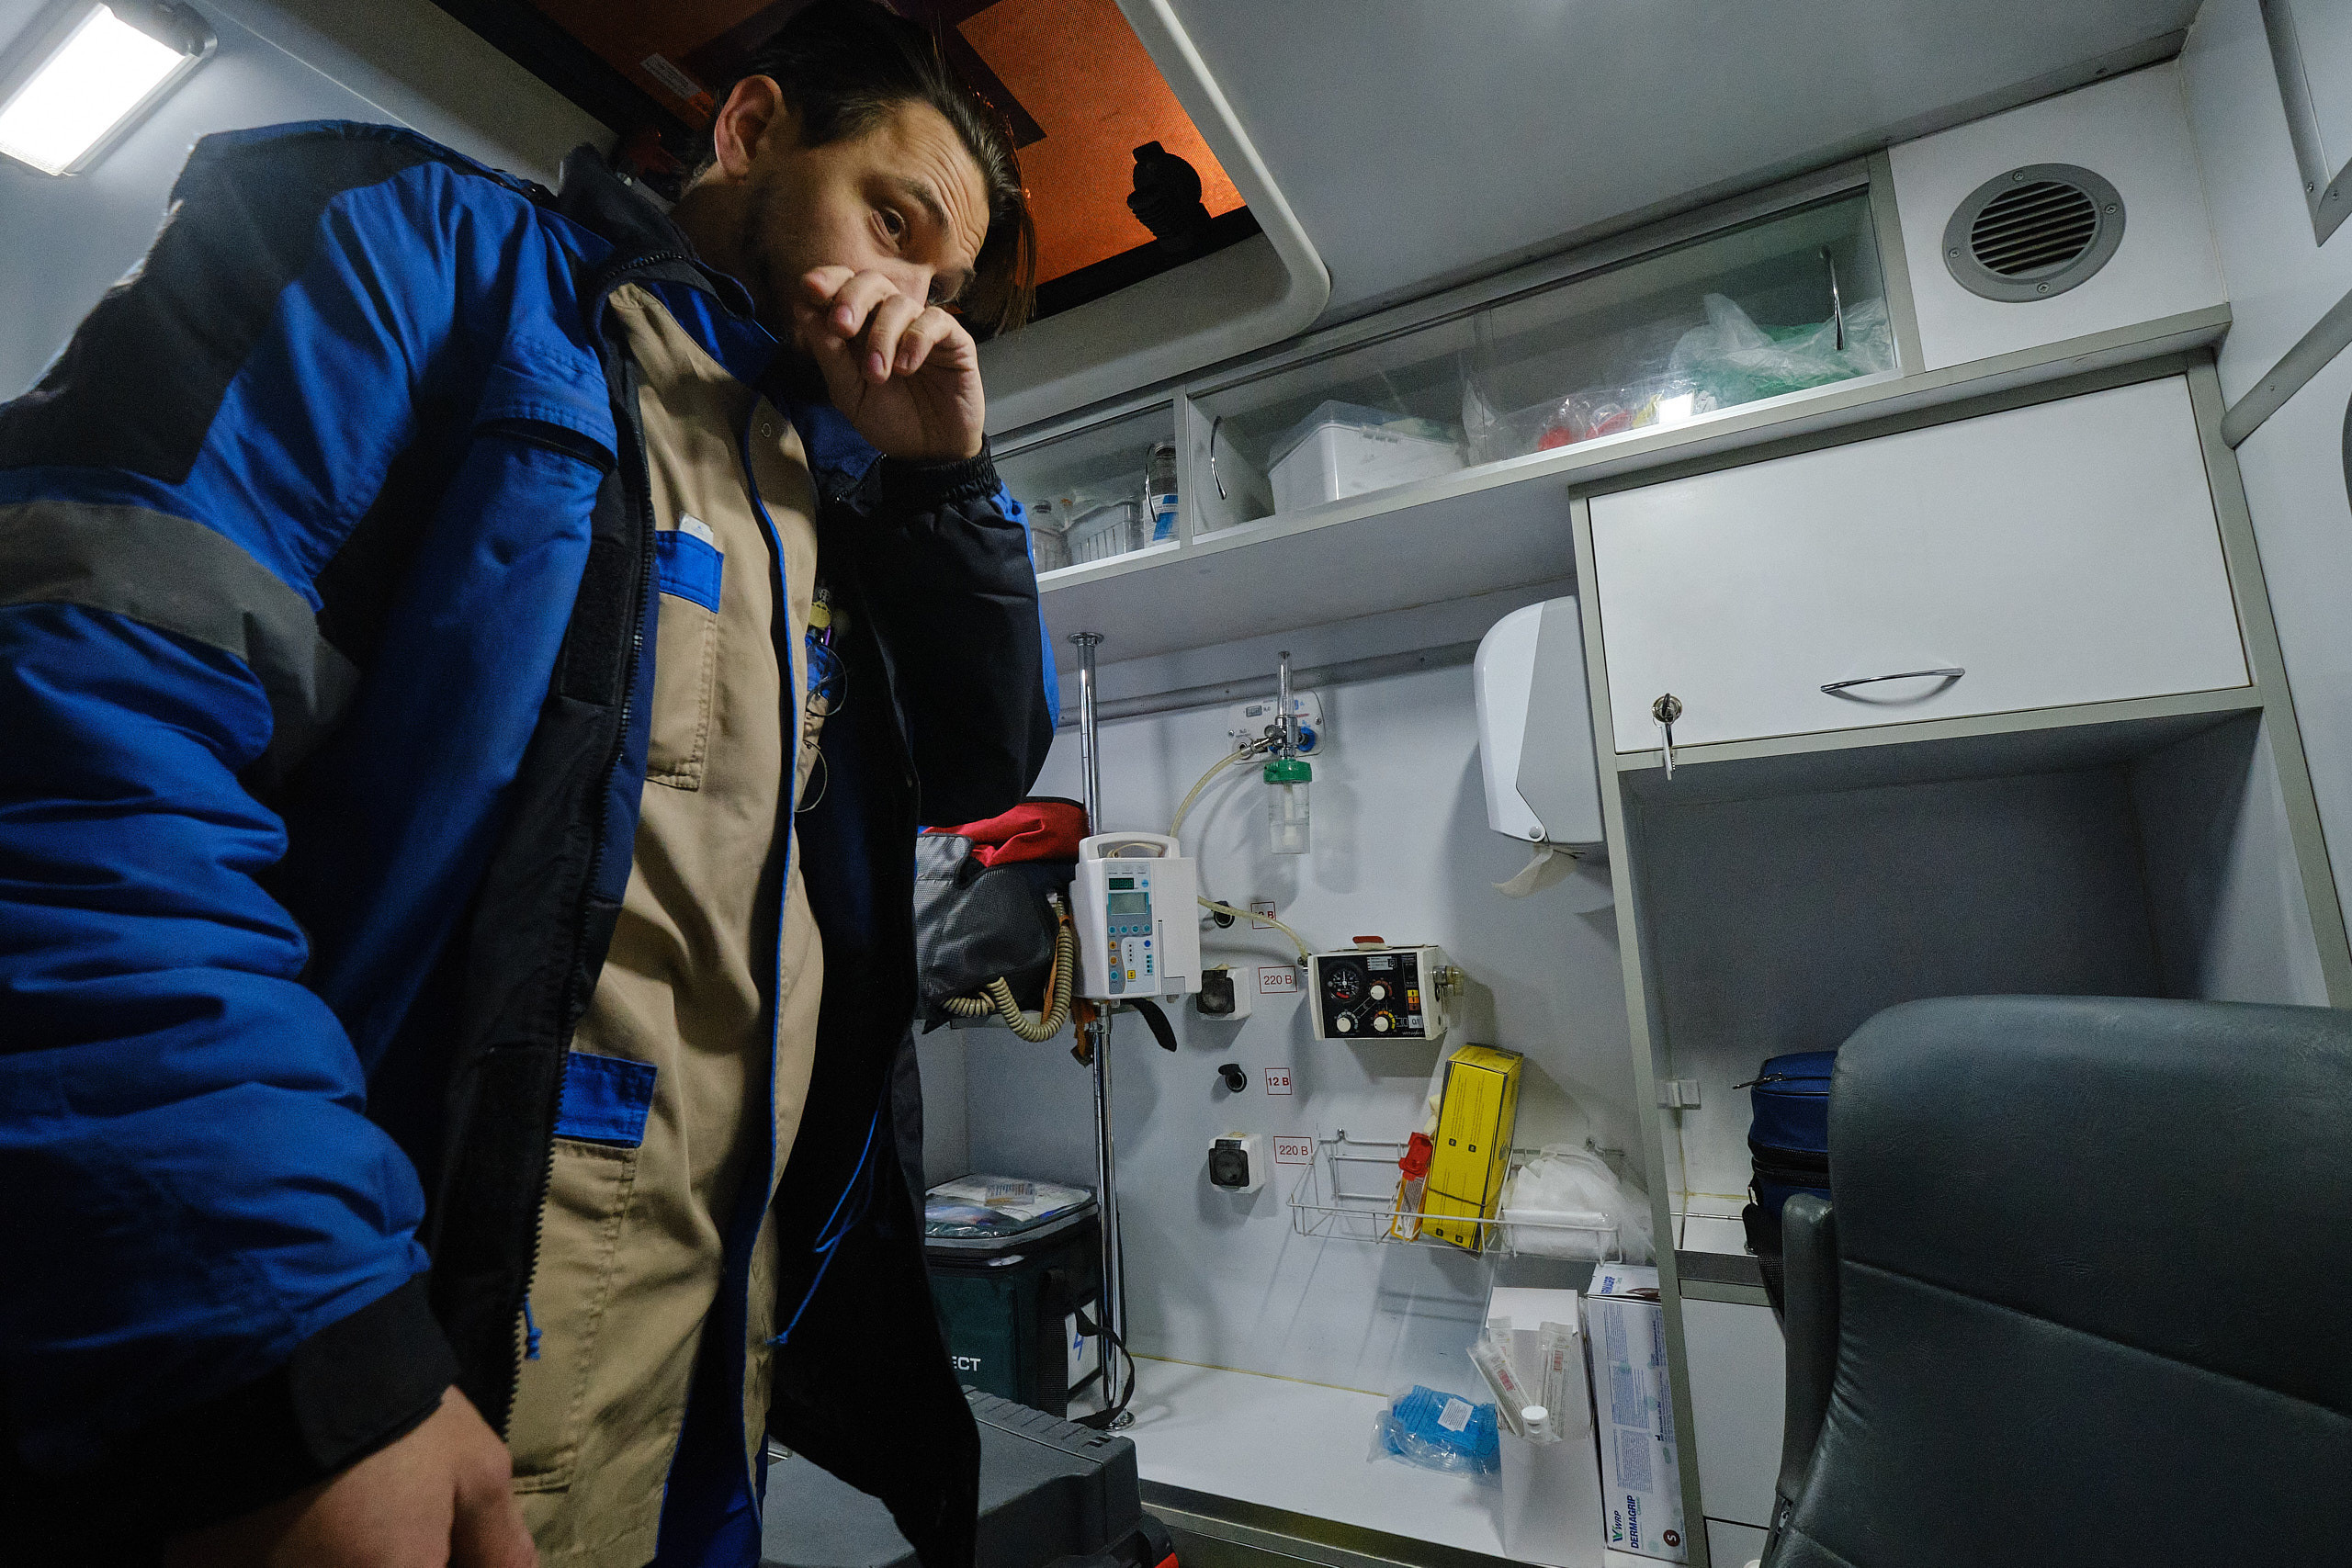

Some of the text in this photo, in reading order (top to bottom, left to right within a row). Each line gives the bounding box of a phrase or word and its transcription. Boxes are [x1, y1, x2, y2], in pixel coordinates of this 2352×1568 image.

[1263, 975, 1283, 986] 220
[1268, 1077, 1280, 1086] 12
[1279, 1145, 1298, 1156] 220
[1614, 1510, 1623, 1530] WRP
[1627, 1495, 1639, 1549] DERMAGRIP
[1667, 1534, 1677, 1542] S
